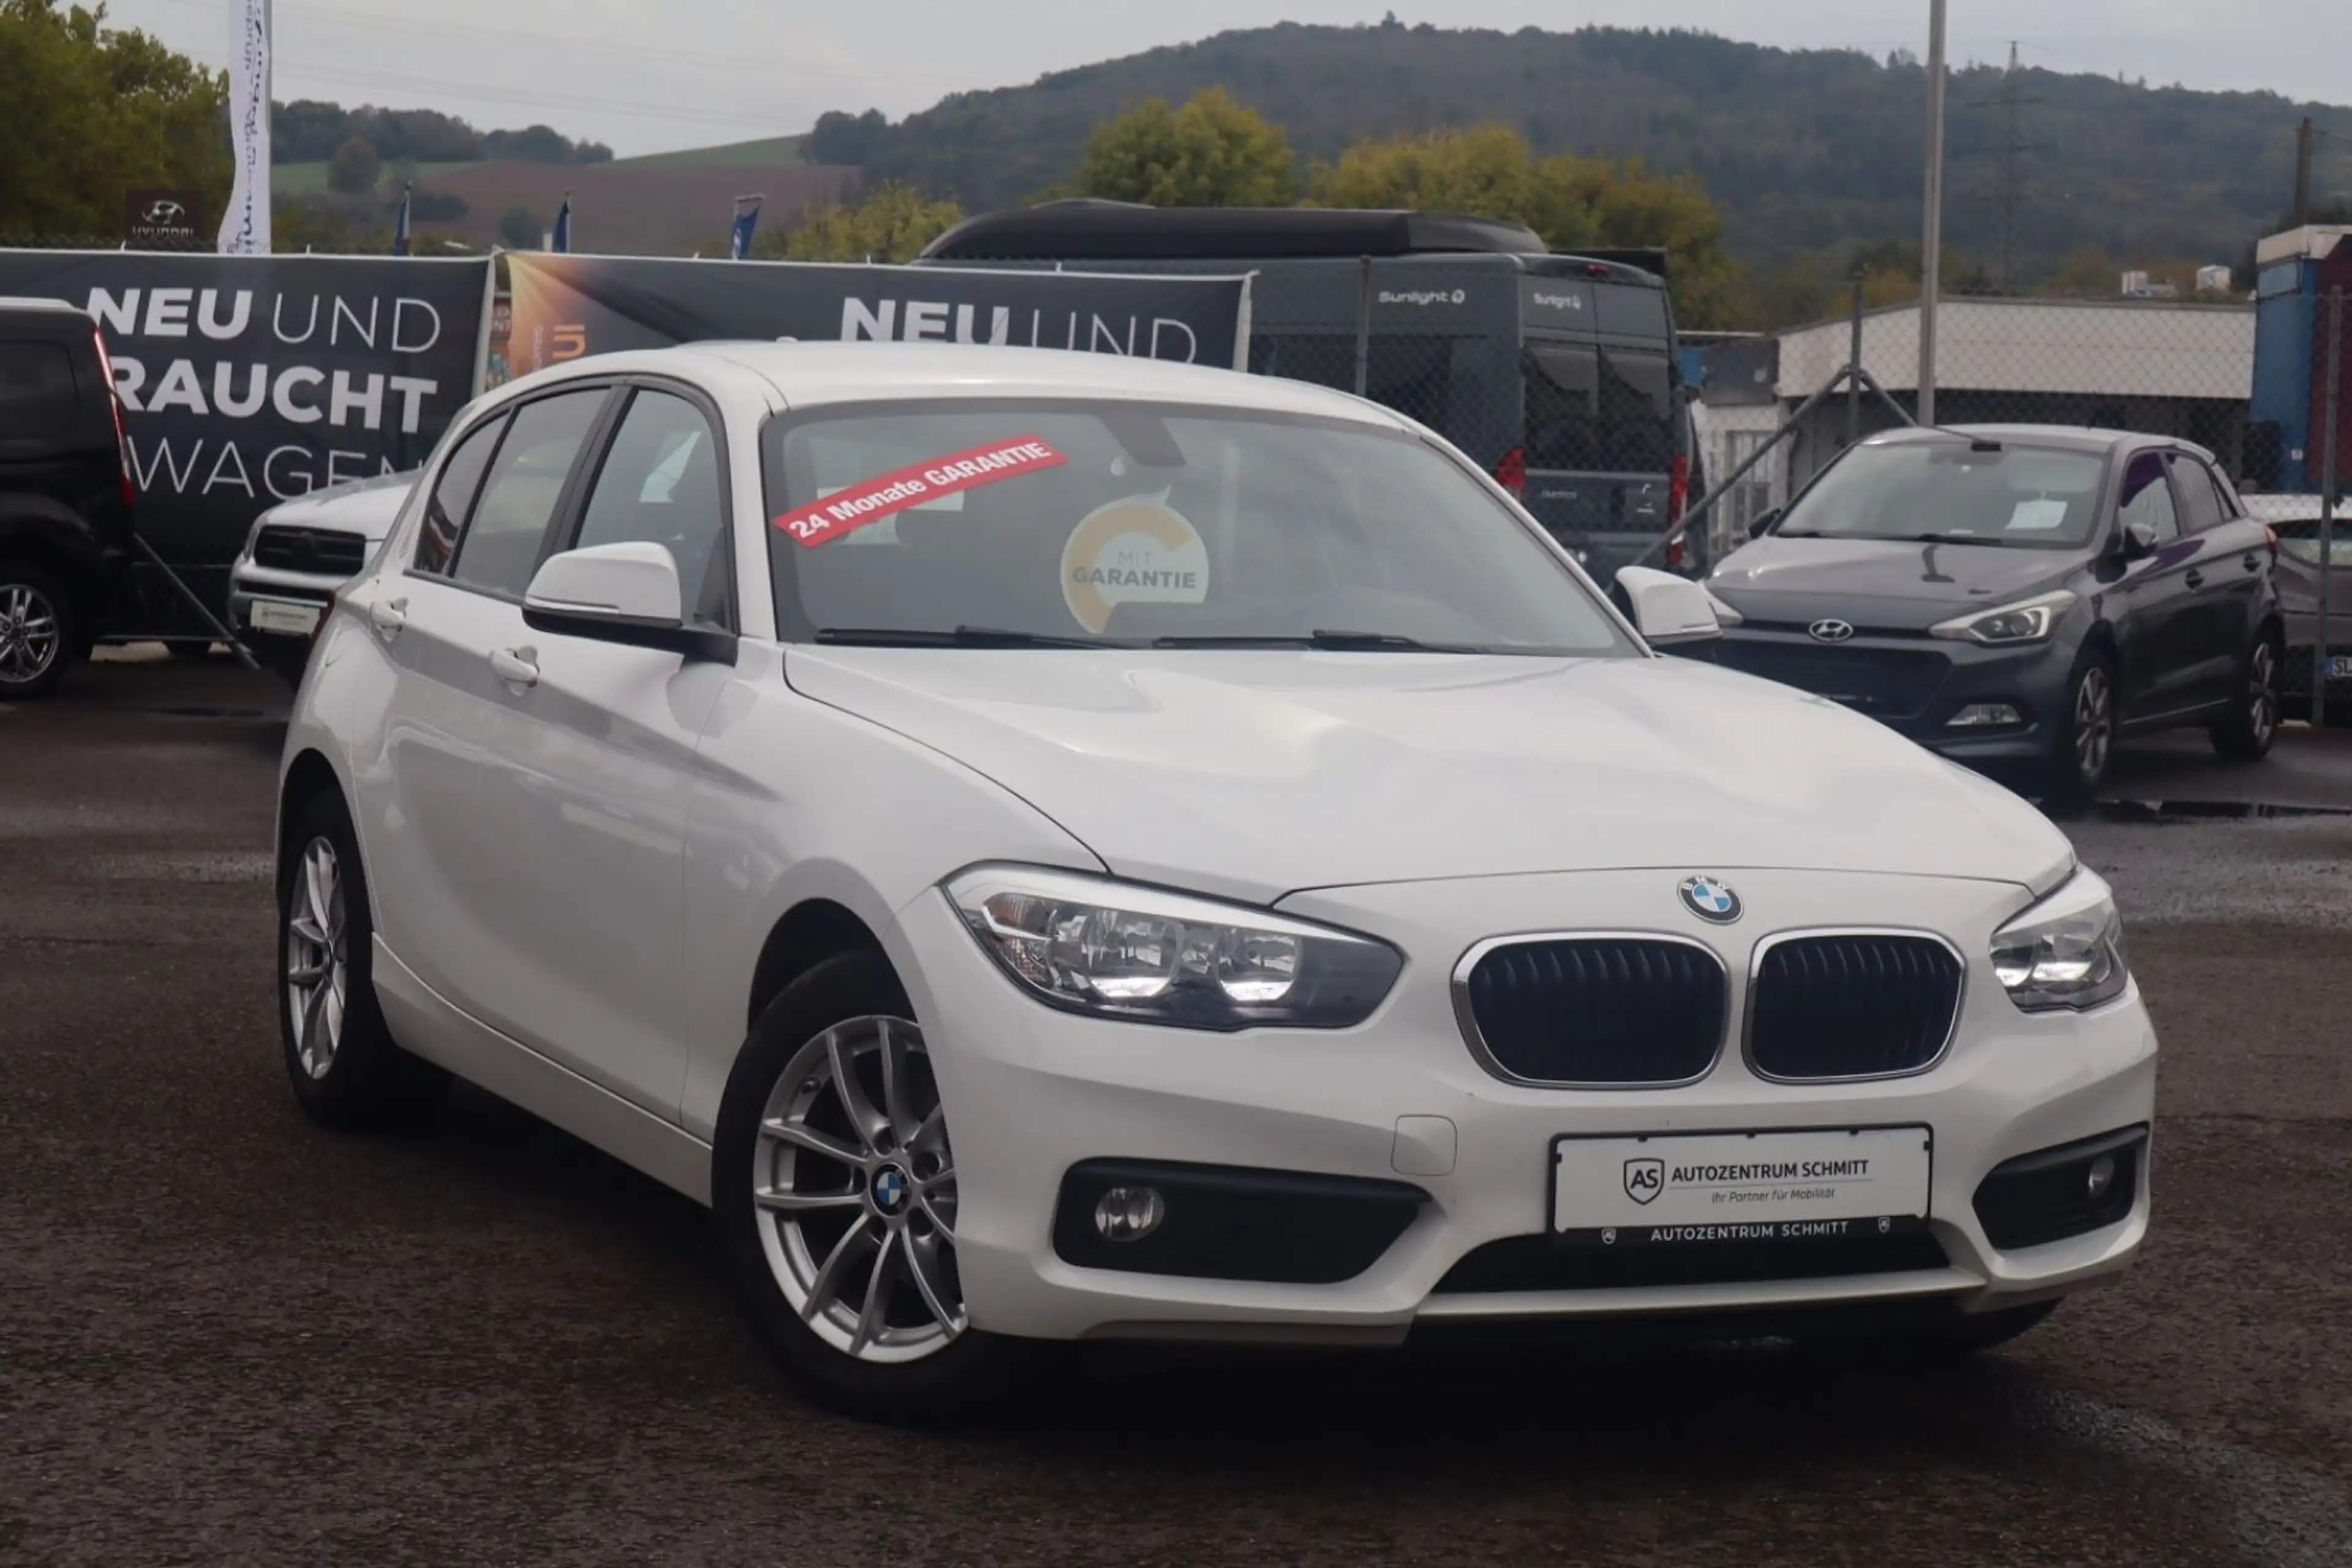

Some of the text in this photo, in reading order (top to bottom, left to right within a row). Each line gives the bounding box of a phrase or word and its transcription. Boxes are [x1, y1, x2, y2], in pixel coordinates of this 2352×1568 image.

[1379, 290, 1449, 306] Sunlight
[86, 287, 253, 340] NEU
[273, 293, 441, 353] UND
[840, 297, 1009, 345] NEU
[790, 441, 1052, 538] 24 Monate GARANTIE
[1118, 551, 1152, 566] MIT
[1072, 567, 1197, 590] GARANTIE
[1630, 1169, 1659, 1189] AS
[1672, 1159, 1869, 1183] AUTOZENTRUM SCHMITT
[1711, 1187, 1836, 1204] Ihr Partner für Mobilität
[1650, 1222, 1848, 1242] AUTOZENTRUM SCHMITT
